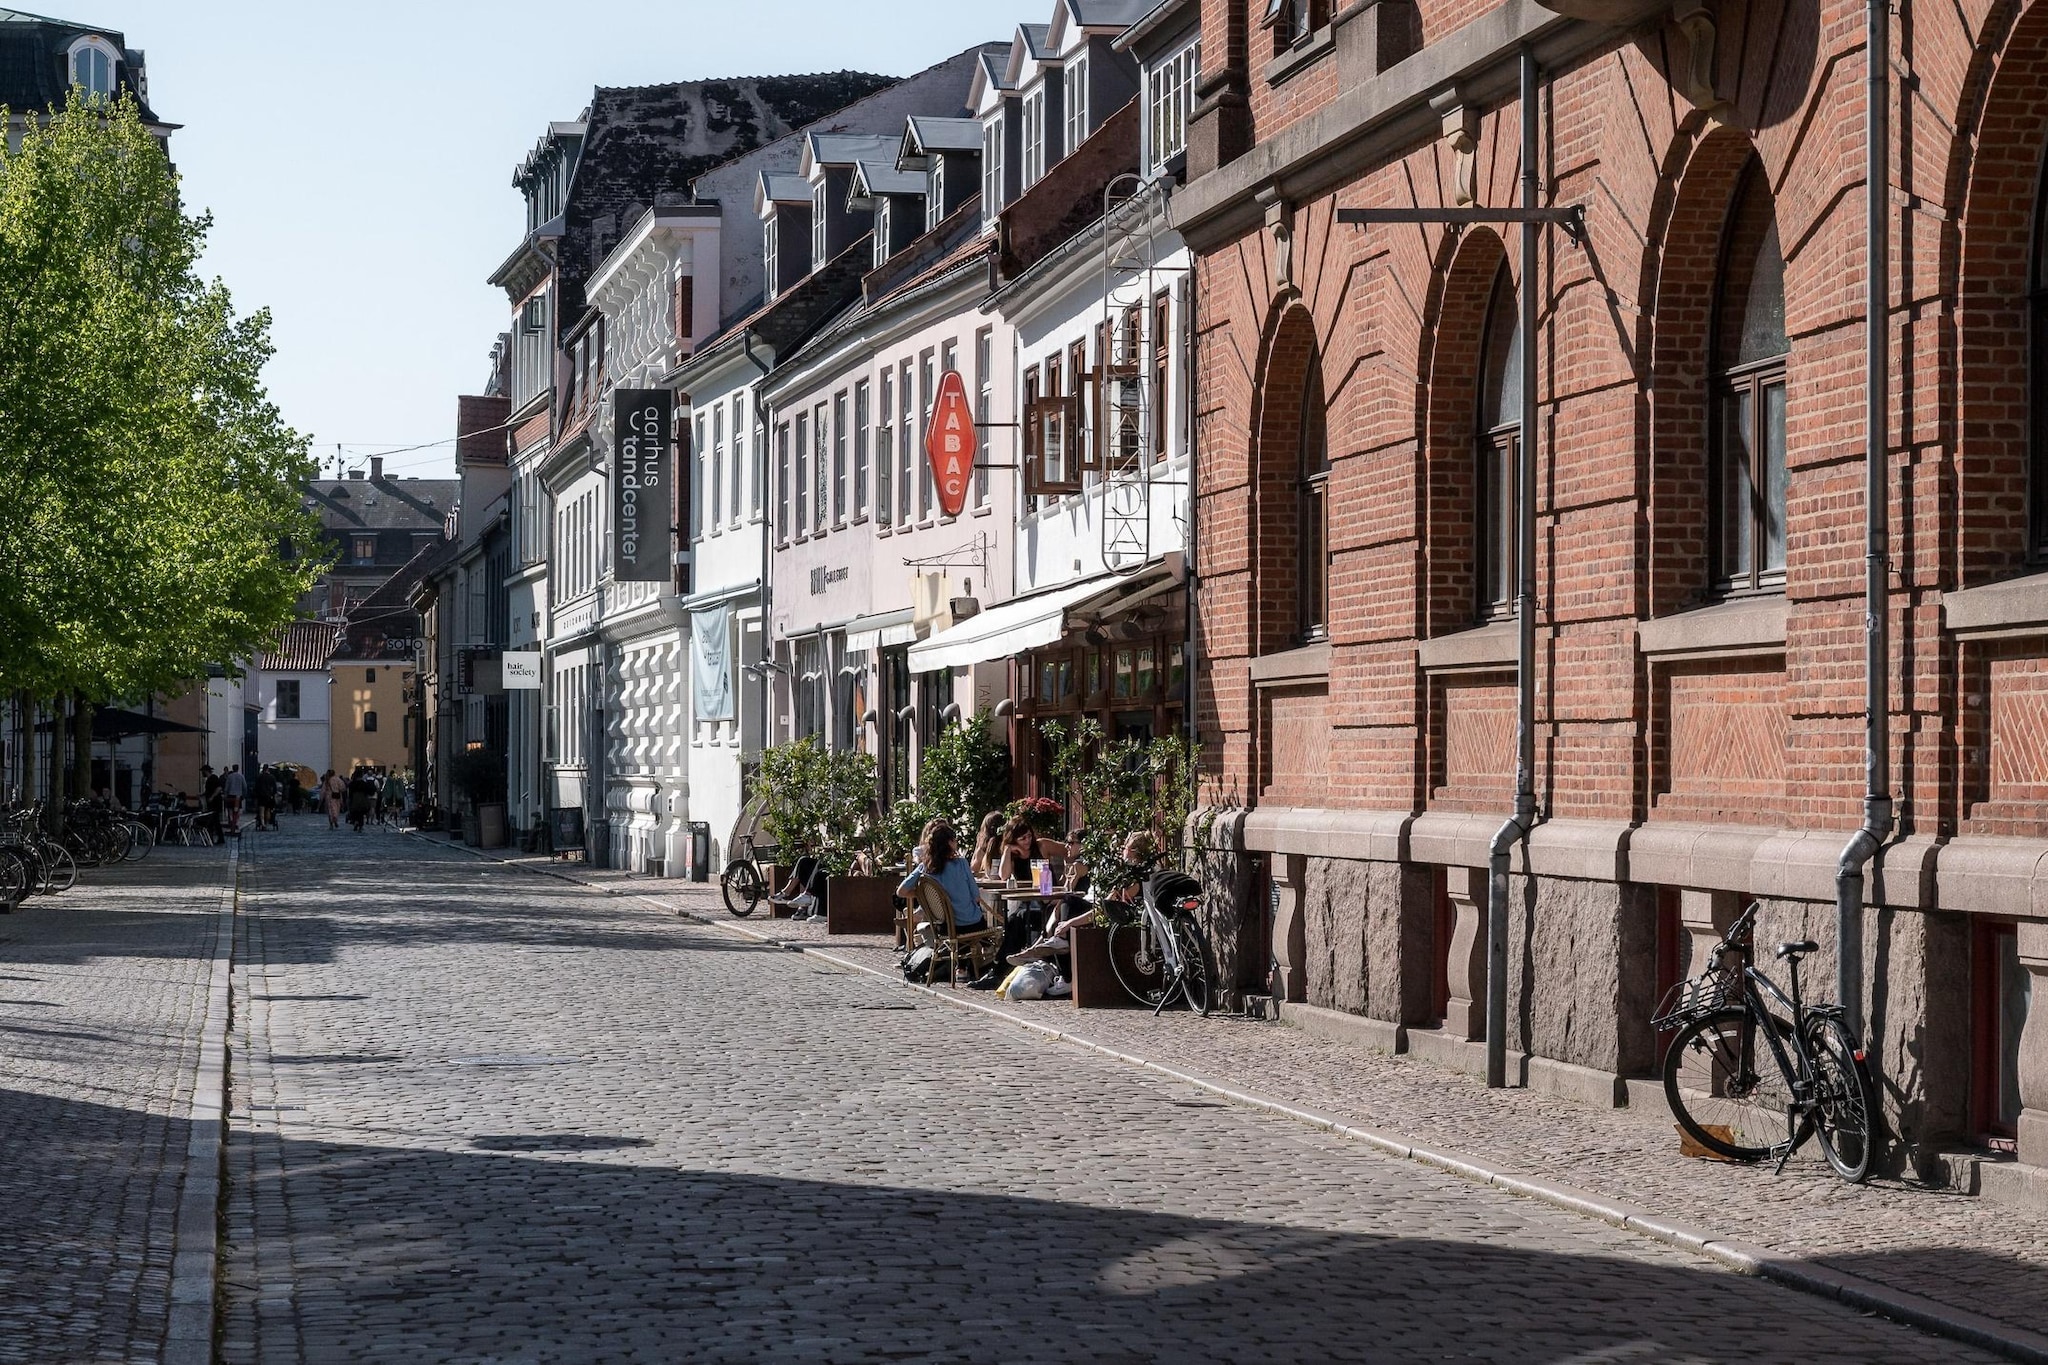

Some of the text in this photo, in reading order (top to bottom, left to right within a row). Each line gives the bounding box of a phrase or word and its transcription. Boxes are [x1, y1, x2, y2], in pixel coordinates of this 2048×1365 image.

[644, 406, 664, 487] aarhus
[944, 391, 961, 496] TABAC
[622, 435, 642, 564] tandcenter
[388, 640, 423, 650] SOO
[507, 662, 524, 670] hair
[510, 669, 536, 677] society
